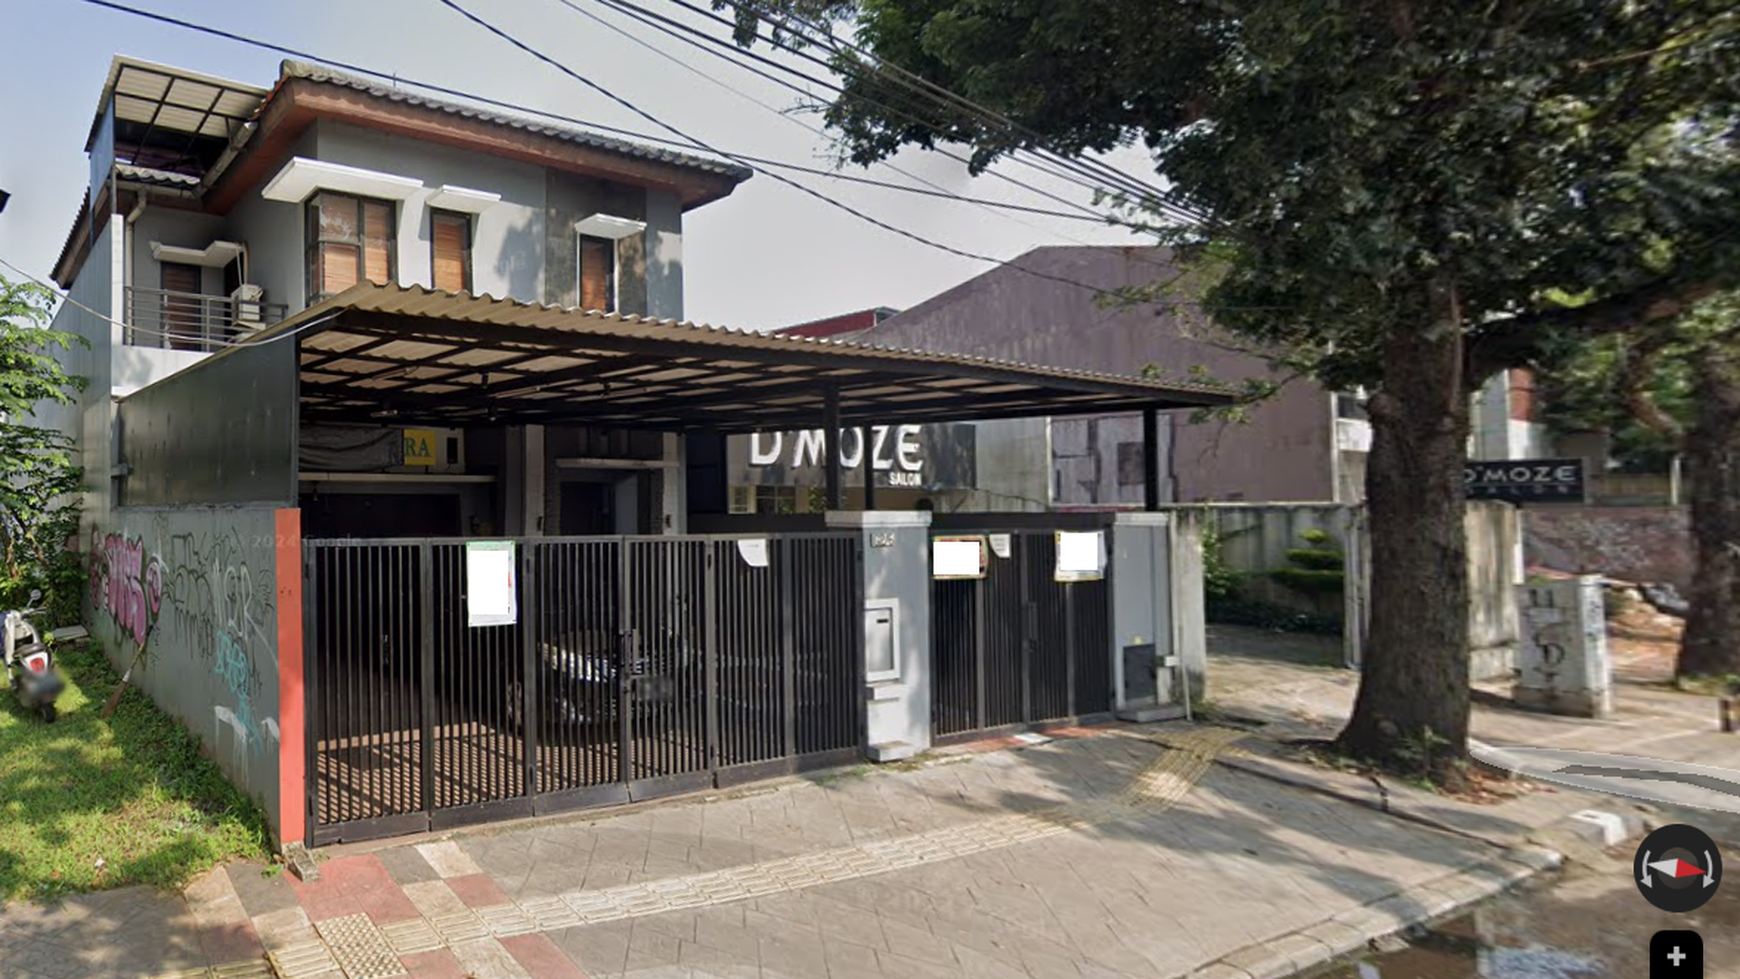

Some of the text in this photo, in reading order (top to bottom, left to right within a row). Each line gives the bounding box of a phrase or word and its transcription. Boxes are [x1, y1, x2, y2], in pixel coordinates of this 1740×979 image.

[404, 437, 432, 458] RA
[751, 425, 922, 471] DMOZE
[889, 471, 922, 486] SALON
